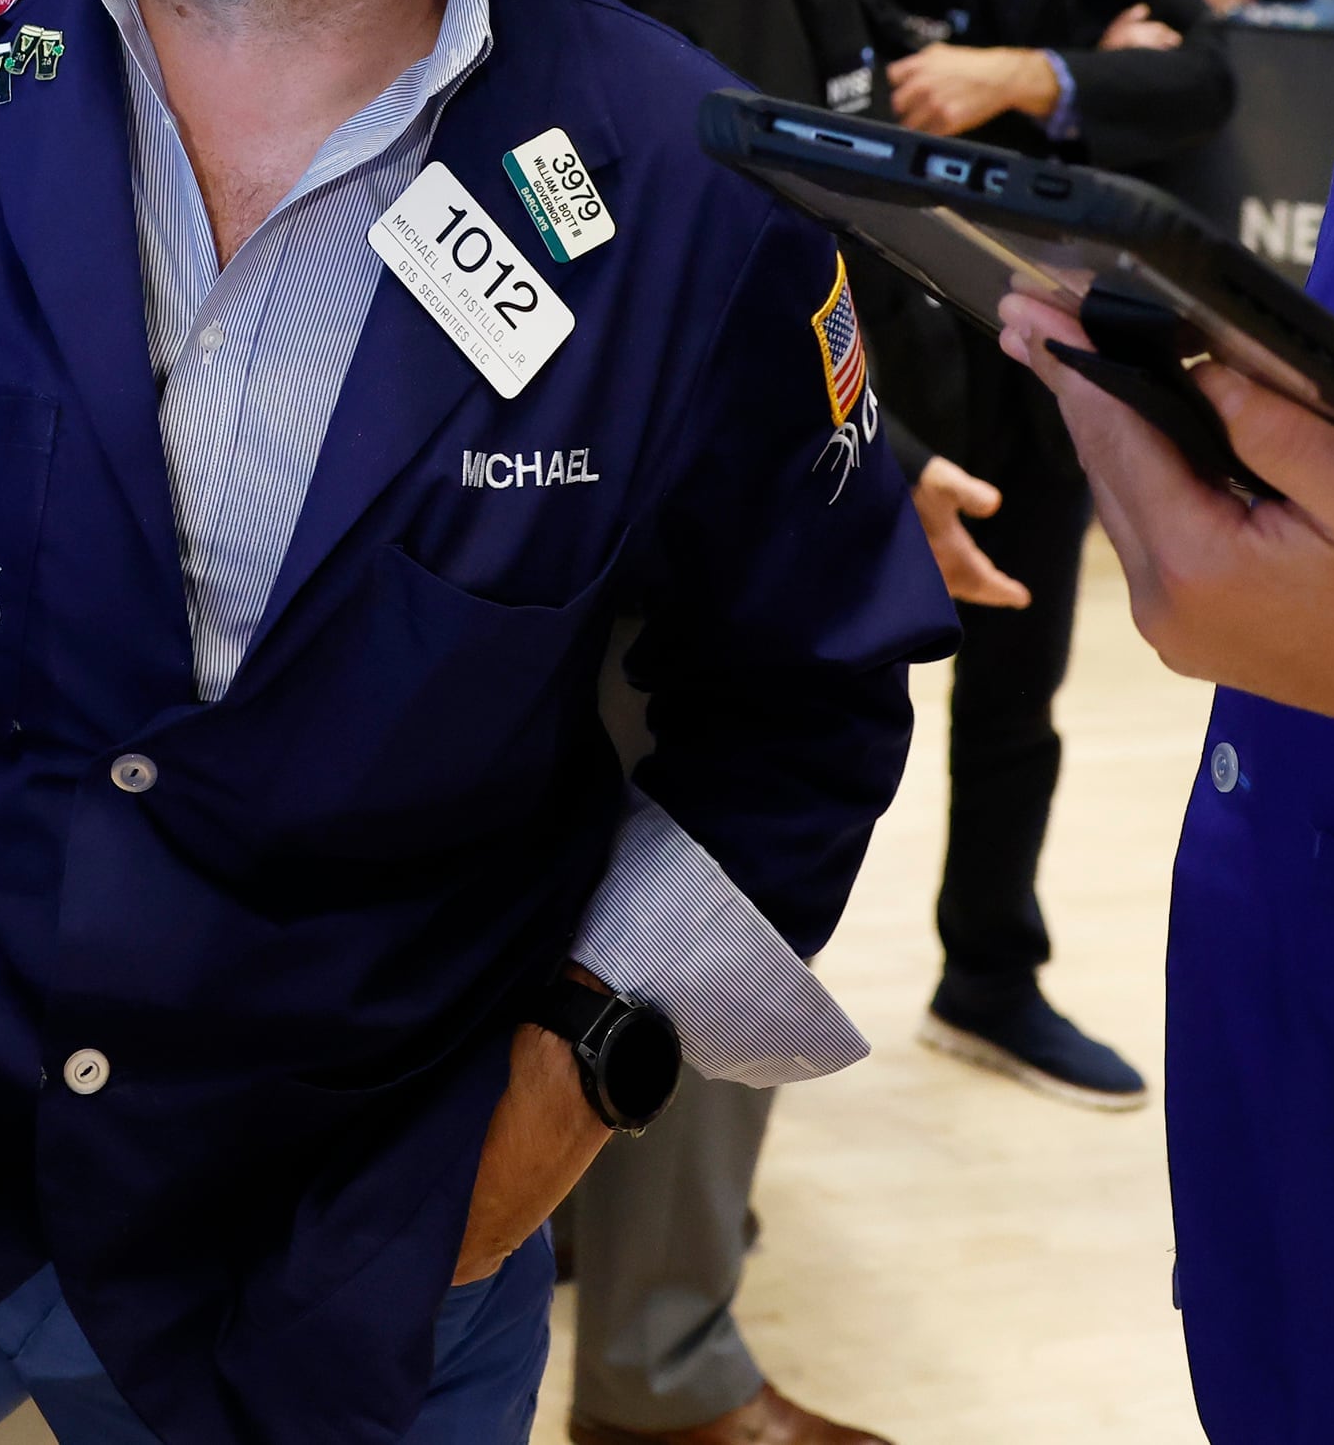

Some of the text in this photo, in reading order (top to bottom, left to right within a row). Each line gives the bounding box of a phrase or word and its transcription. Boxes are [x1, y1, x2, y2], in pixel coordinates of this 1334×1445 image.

[520, 186, 550, 232] BARCLAYS
[533, 155, 559, 195] WILLIAM
[553, 195, 563, 204] J.
[558, 203, 578, 228] BOTT
[533, 180, 562, 226] GOVERNOR
[552, 153, 601, 221] 3979
[392, 214, 438, 271] MICHAEL
[435, 205, 539, 330] 1012
[398, 260, 490, 365] GTS SECURITIES LLC
[462, 447, 599, 489] MICHAEL
